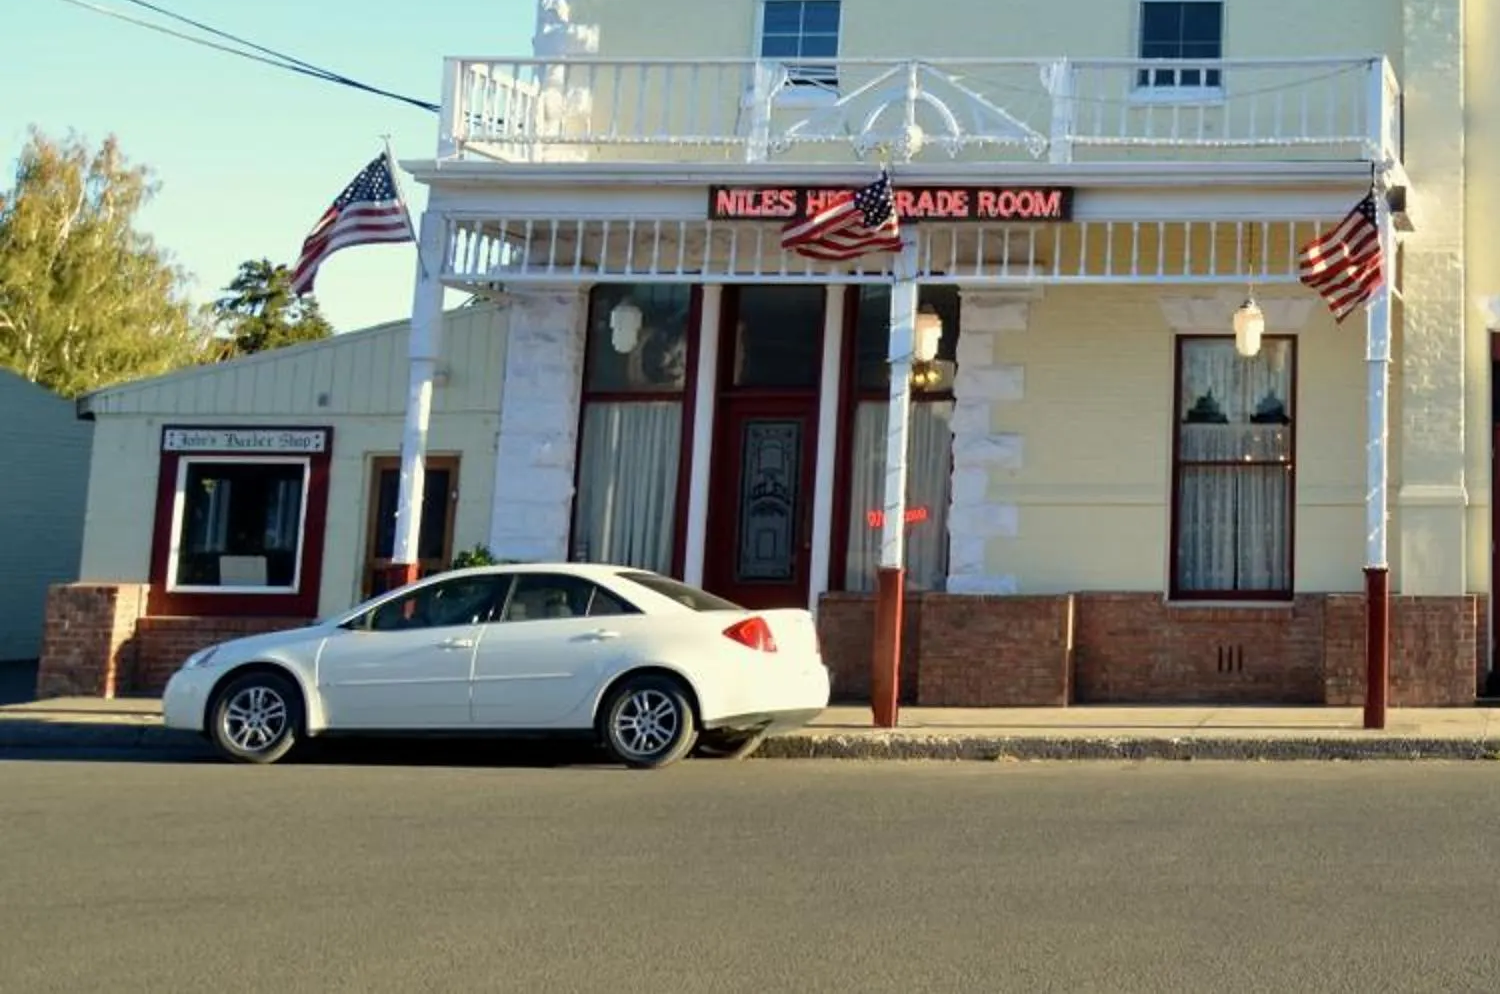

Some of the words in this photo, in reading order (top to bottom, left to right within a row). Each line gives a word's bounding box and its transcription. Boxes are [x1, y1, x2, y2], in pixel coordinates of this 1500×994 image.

[716, 189, 797, 217] NILES
[977, 189, 1062, 217] ROOM
[279, 432, 311, 449] Shop
